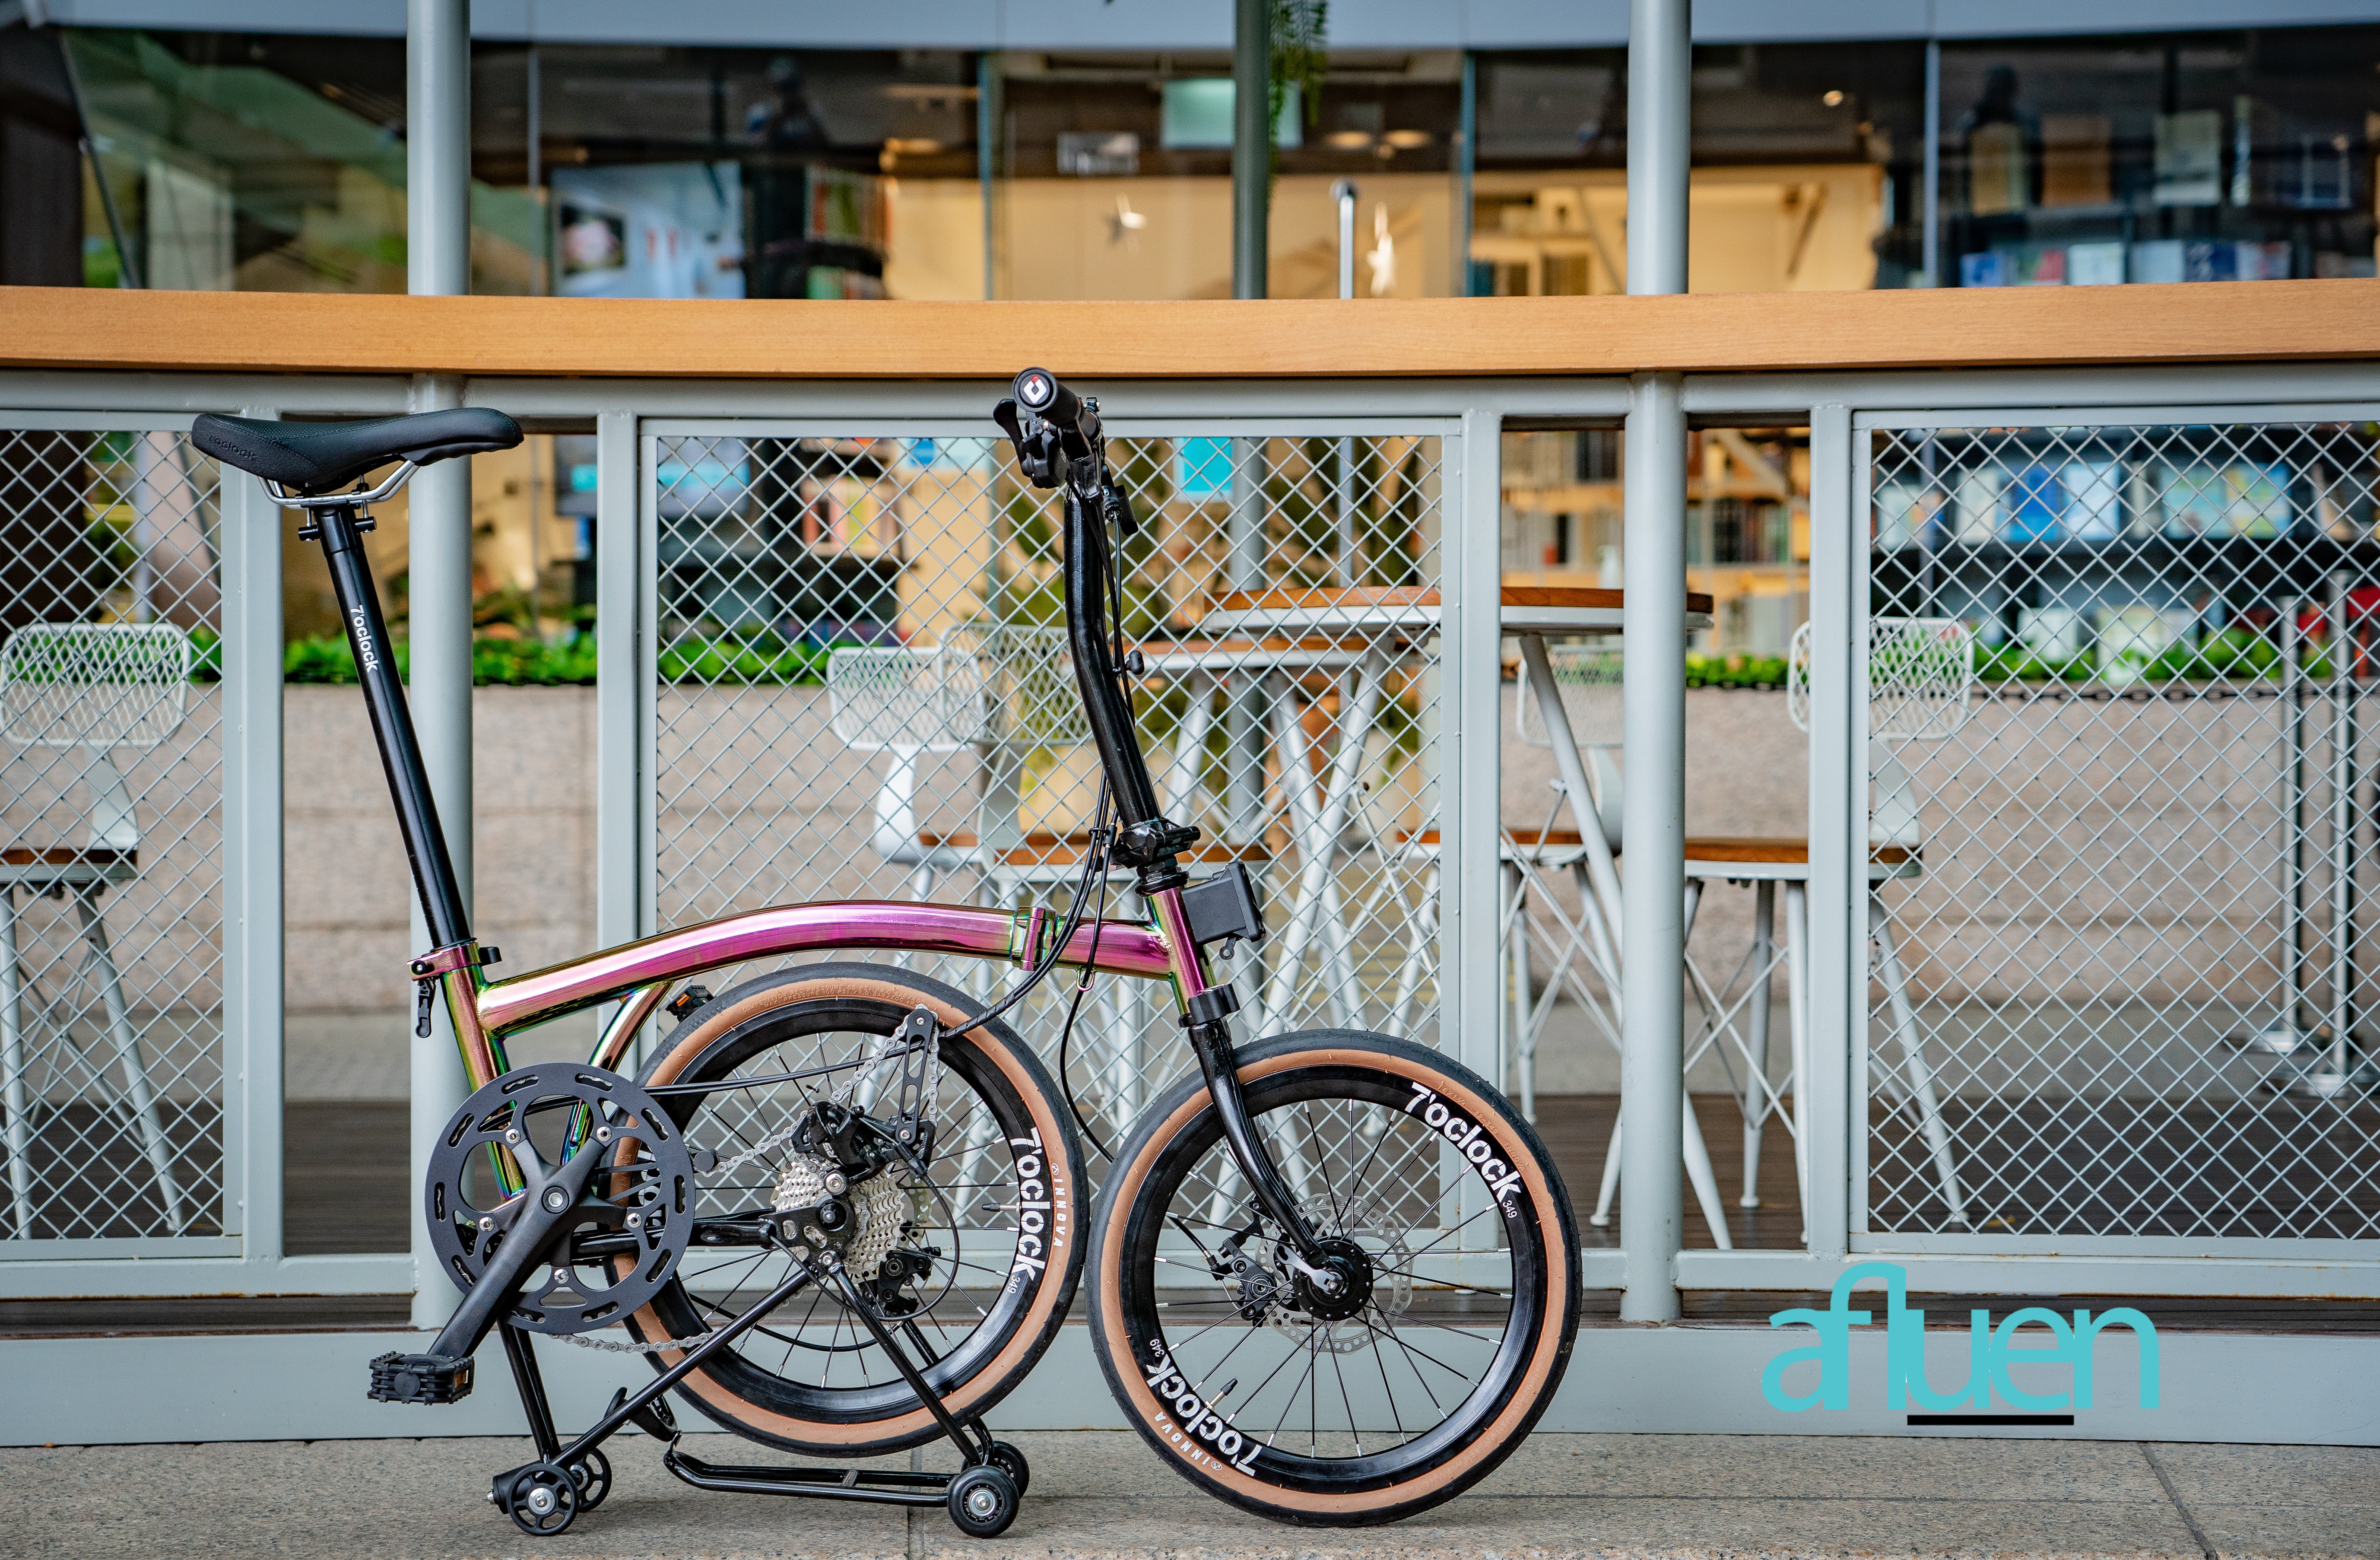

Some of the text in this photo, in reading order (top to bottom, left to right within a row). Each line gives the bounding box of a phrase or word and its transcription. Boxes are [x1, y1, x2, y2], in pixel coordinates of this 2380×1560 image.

[349, 605, 379, 673] 7'oclock
[741, 992, 787, 1013] COMPETITION
[783, 991, 819, 1001] PRESSURE
[1404, 1081, 1521, 1218] 7'oclock 349
[1473, 1109, 1498, 1135] 32-349
[1504, 1143, 1526, 1172] INNOVA
[1007, 1127, 1051, 1294] 7'oclock 349
[1054, 1178, 1067, 1248] INNOVA
[1146, 1338, 1262, 1477] 7'oclock 349
[1154, 1411, 1211, 1465] INNOVA
